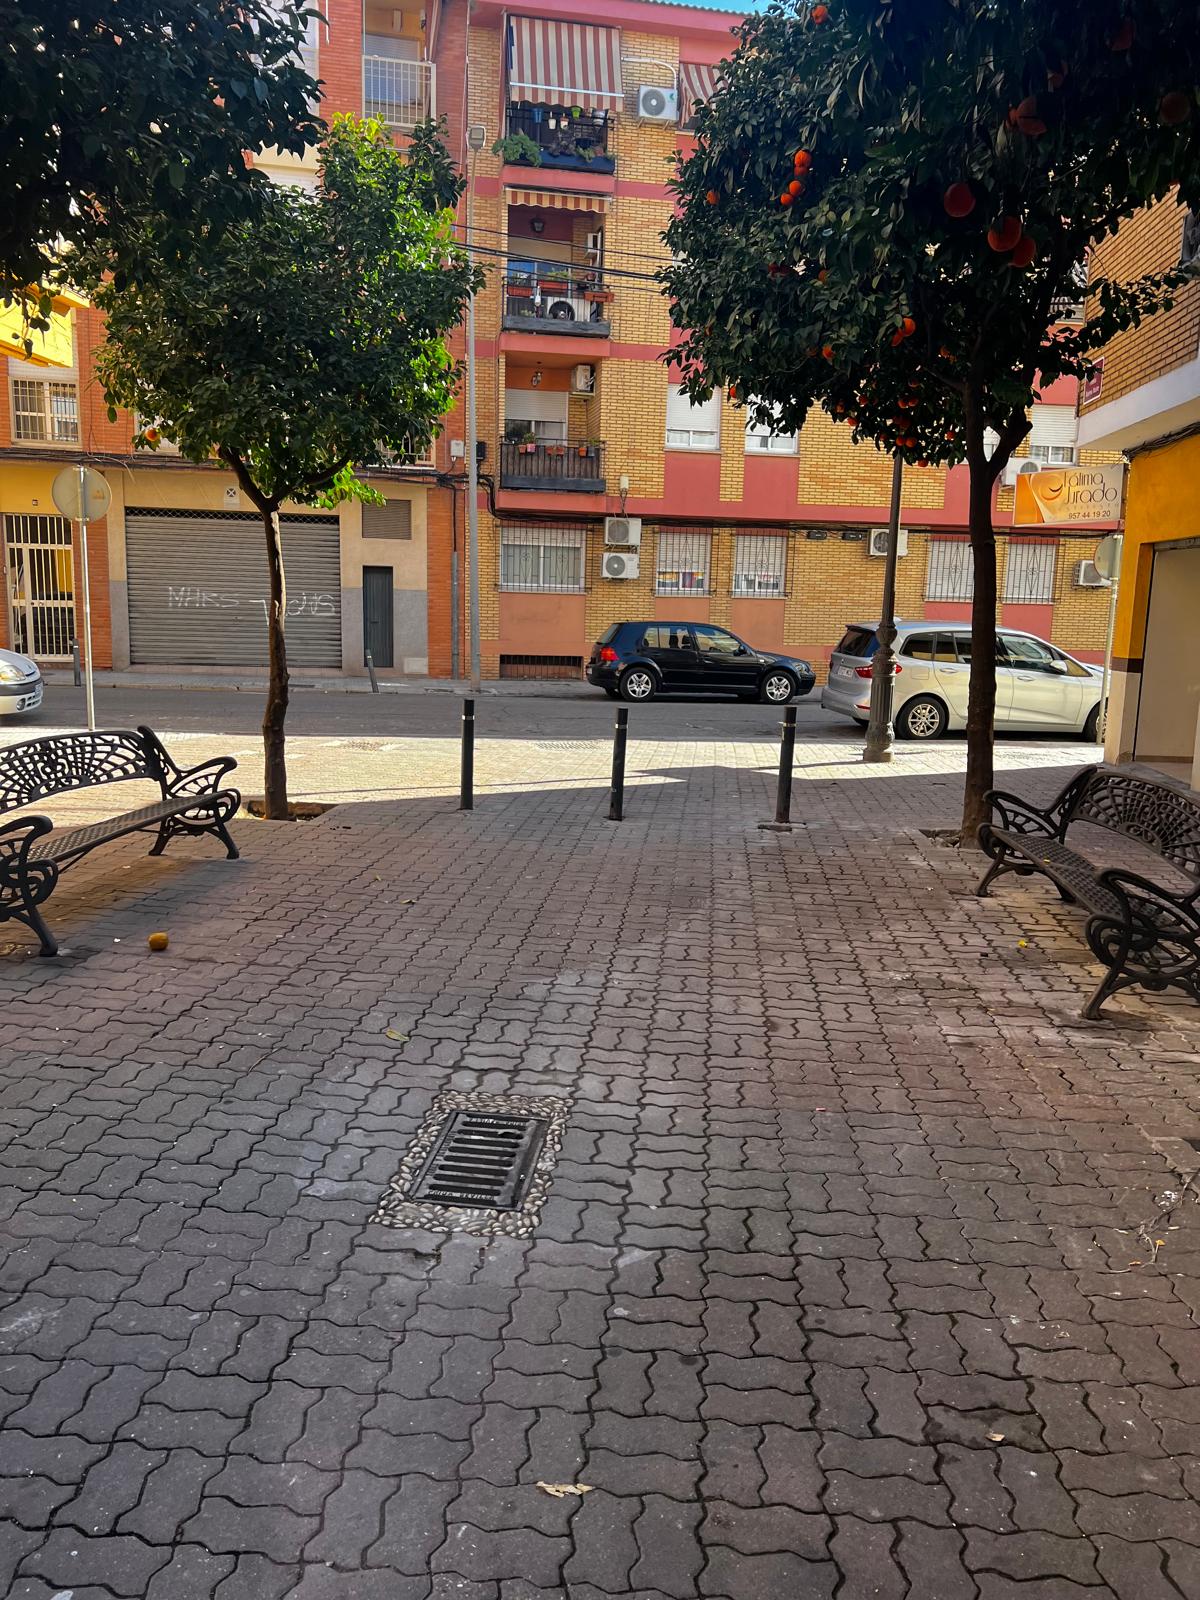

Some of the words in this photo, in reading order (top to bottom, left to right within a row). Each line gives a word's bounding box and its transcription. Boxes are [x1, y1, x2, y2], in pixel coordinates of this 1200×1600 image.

[1068, 511, 1081, 520] 957
[1081, 511, 1091, 519] 44
[1093, 510, 1101, 518] 19
[1101, 509, 1111, 517] 20
